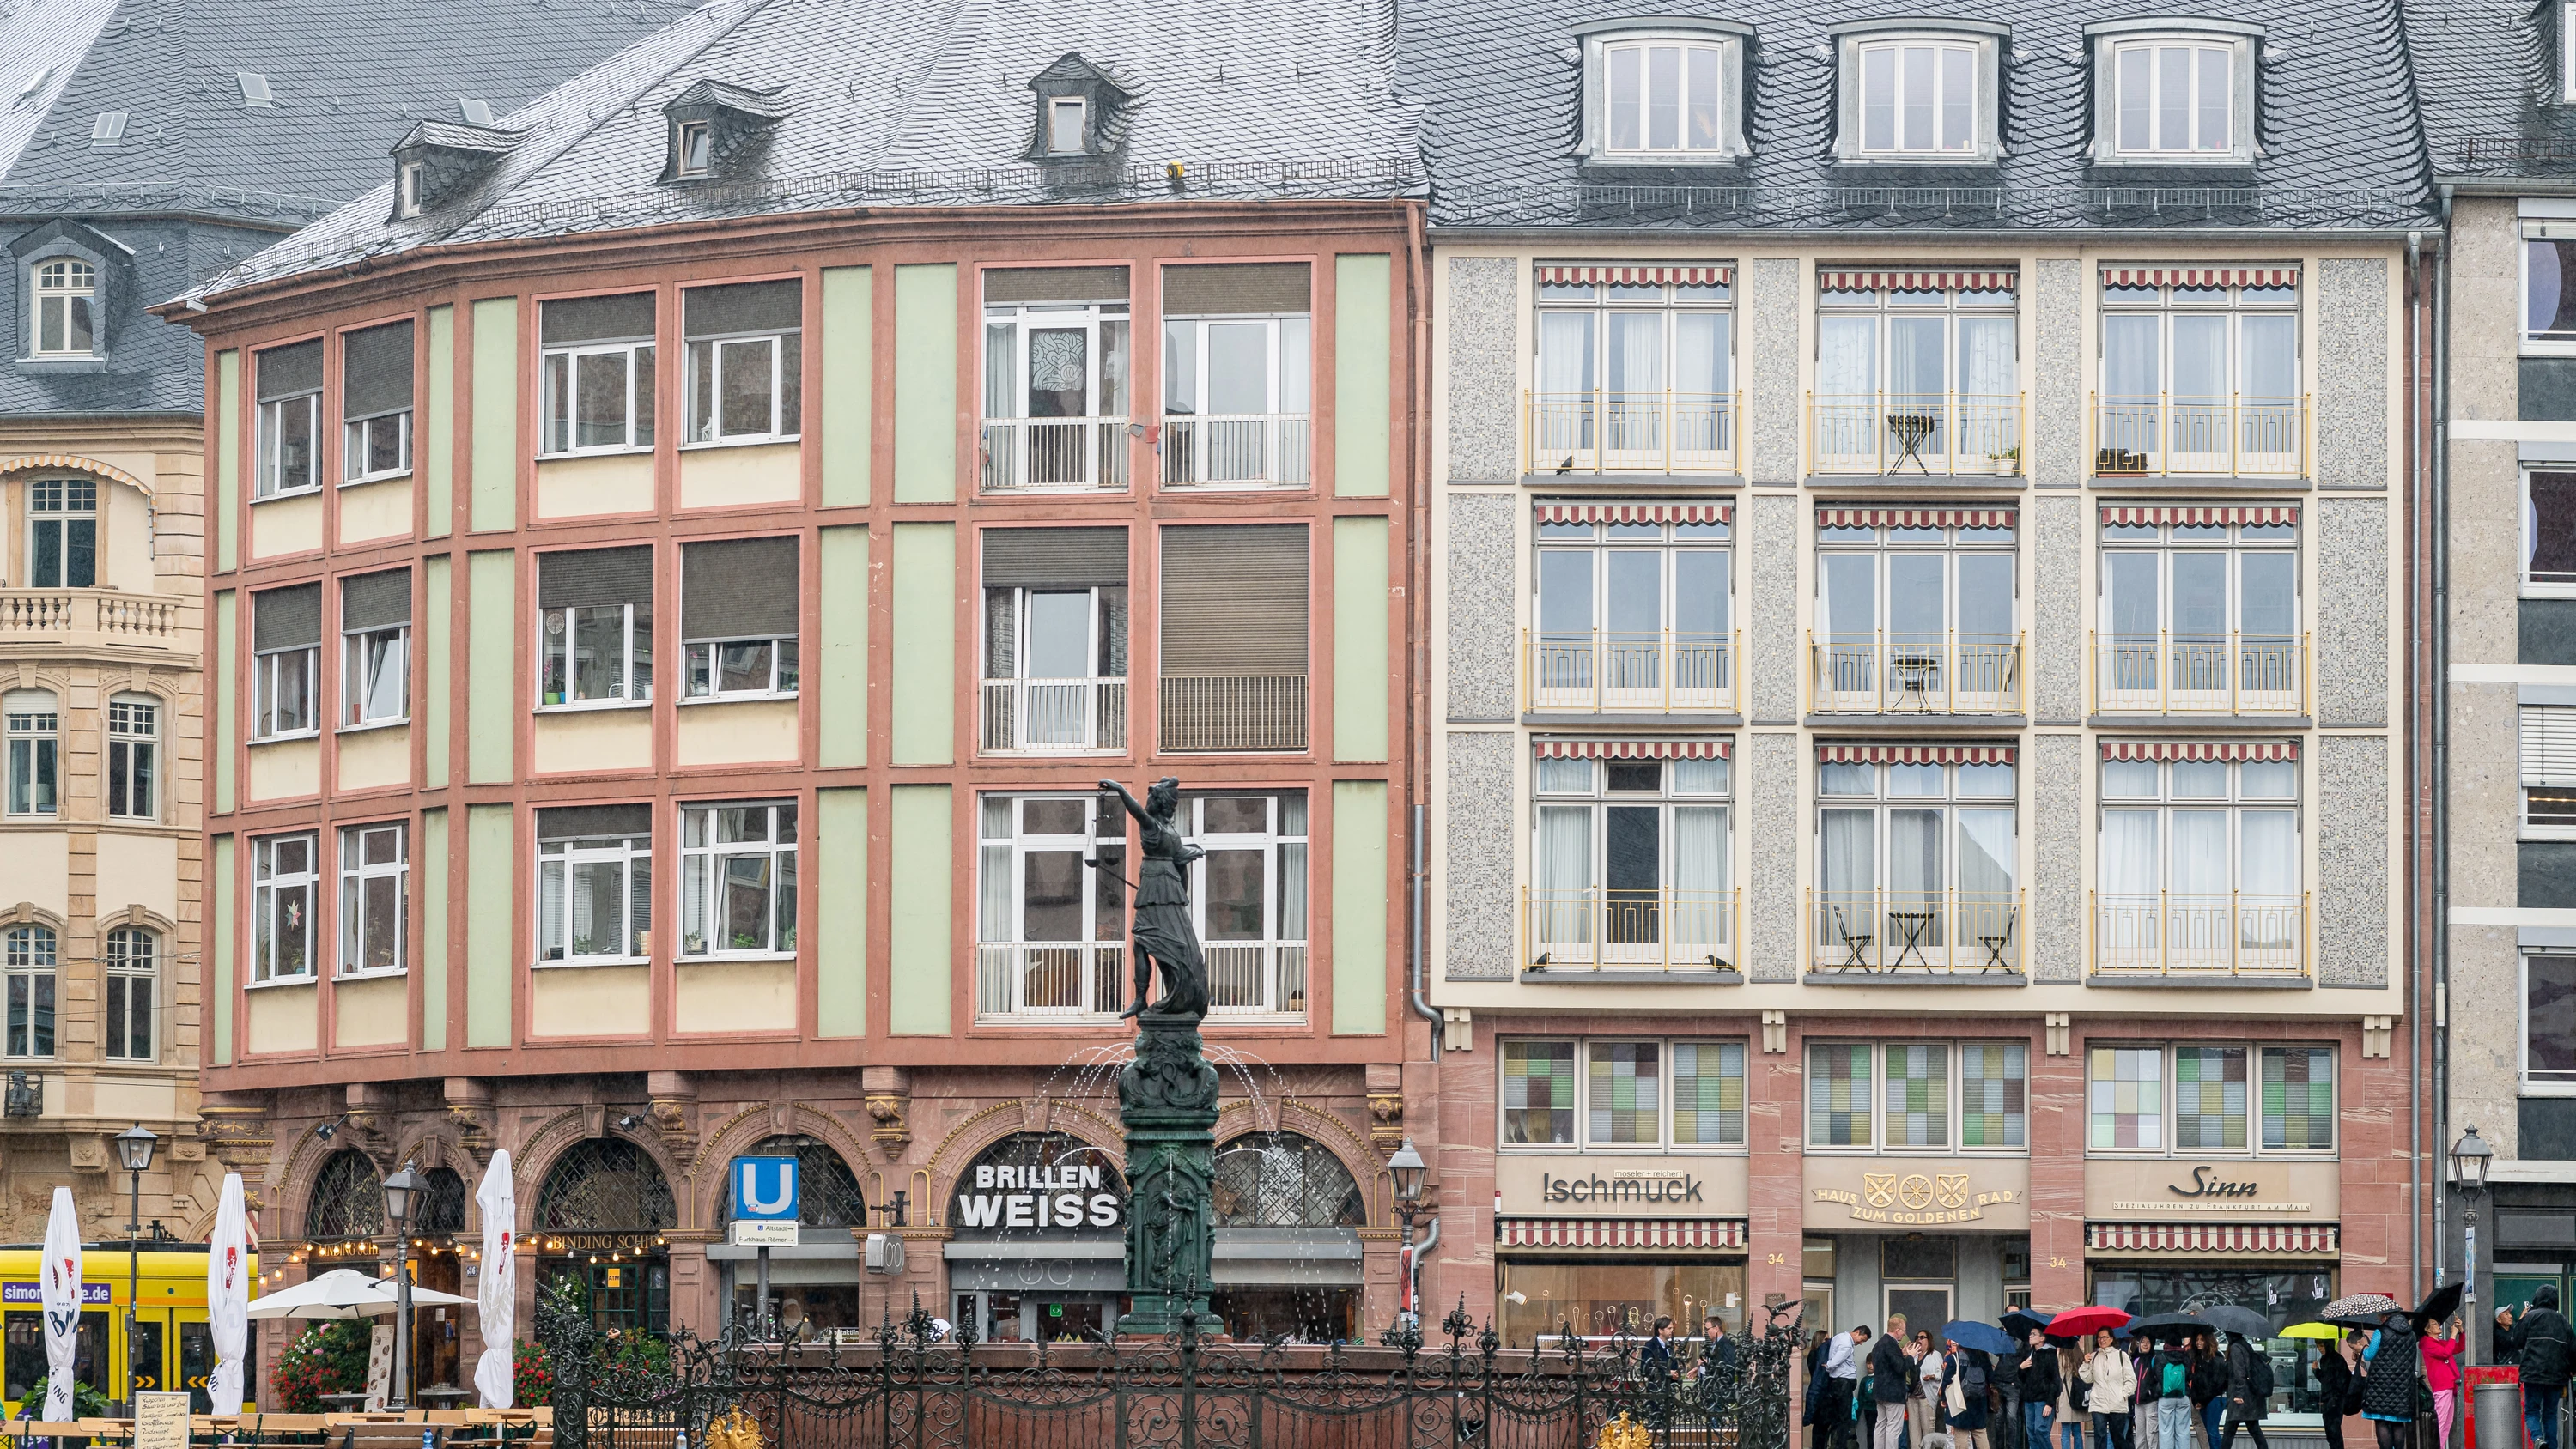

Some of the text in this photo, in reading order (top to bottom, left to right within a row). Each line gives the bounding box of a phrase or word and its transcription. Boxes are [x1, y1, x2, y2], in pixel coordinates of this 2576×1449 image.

[976, 1165, 1100, 1189] BRILLEN
[2168, 1165, 2258, 1197] Sinn
[743, 1163, 793, 1215] U
[1544, 1173, 1703, 1203] !schmuck
[1818, 1189, 1857, 1204] HAUS
[1978, 1191, 2013, 1205] RAD
[959, 1193, 1118, 1228] WEISS
[1853, 1206, 1980, 1223] ZUM GOLDENEN
[553, 1235, 612, 1249] BINDING
[1768, 1253, 1784, 1264] 34
[2050, 1257, 2067, 1268] 34
